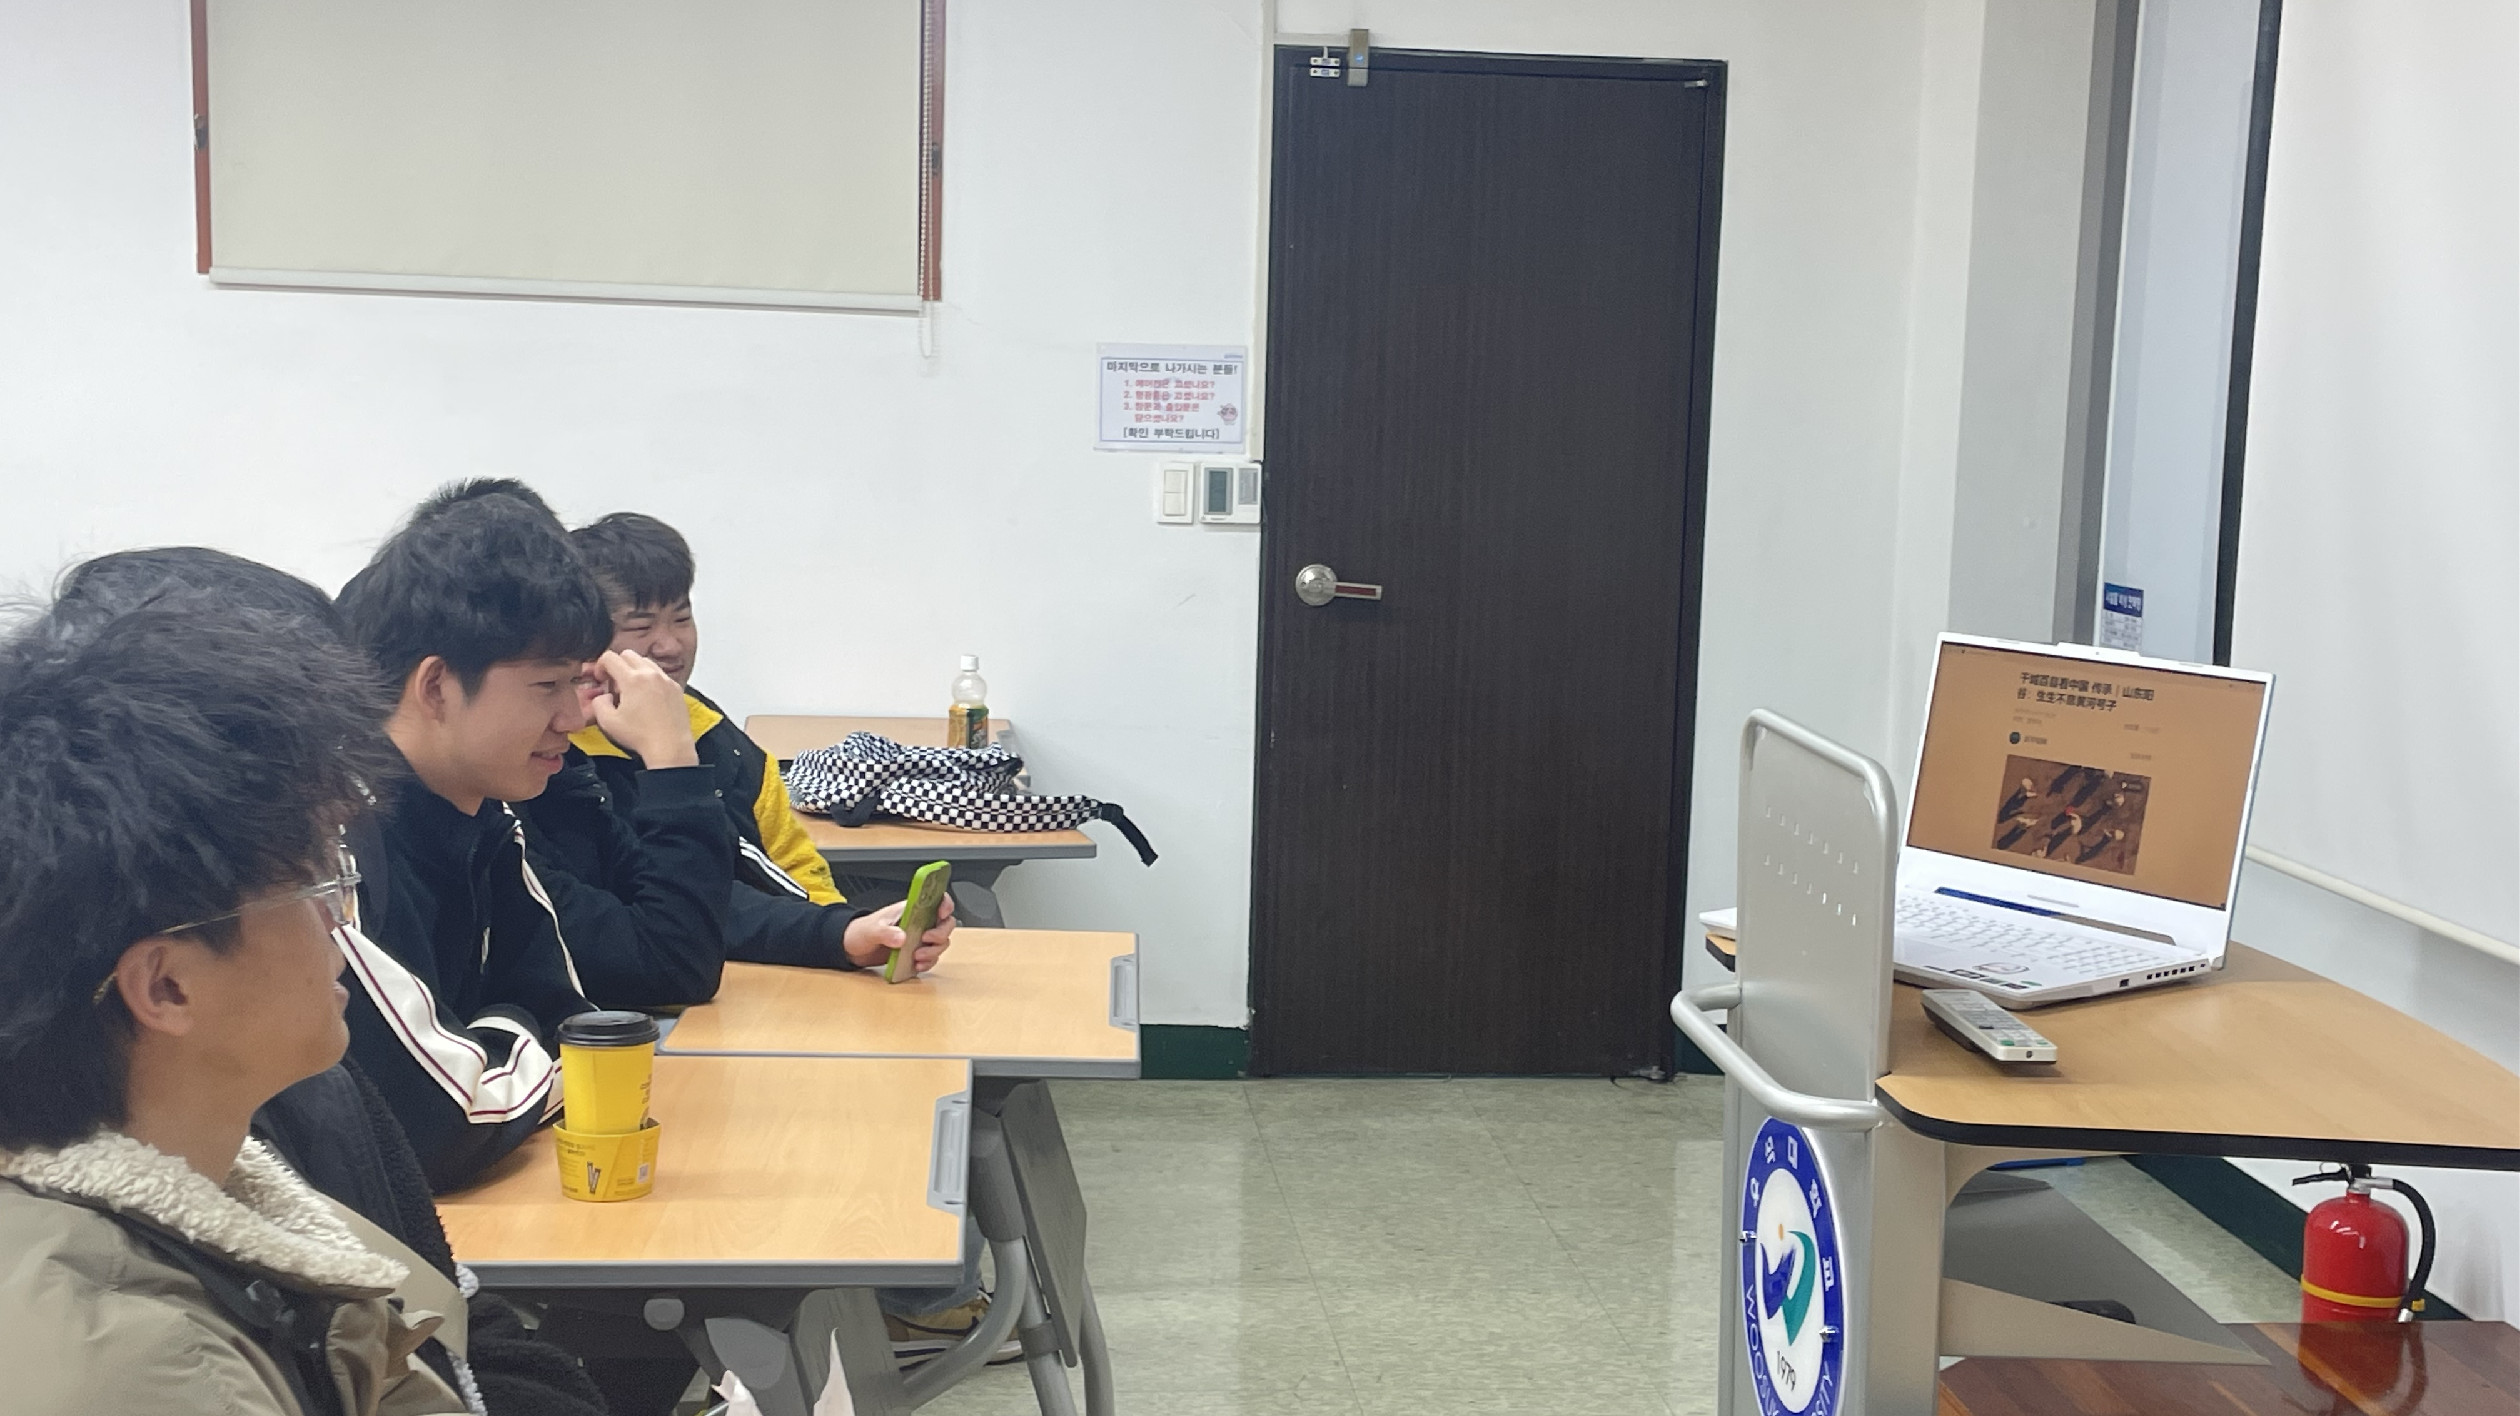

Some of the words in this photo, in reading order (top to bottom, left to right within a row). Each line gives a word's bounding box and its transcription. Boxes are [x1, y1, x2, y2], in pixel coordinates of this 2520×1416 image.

[1107, 361, 1160, 373] 마지막으로
[1166, 363, 1208, 375] 나가시는
[1213, 364, 1238, 375] 분들!
[1123, 427, 1149, 438] [확인
[1153, 428, 1220, 439] 부탁드립니다]
[1777, 1350, 1797, 1391] 1979
